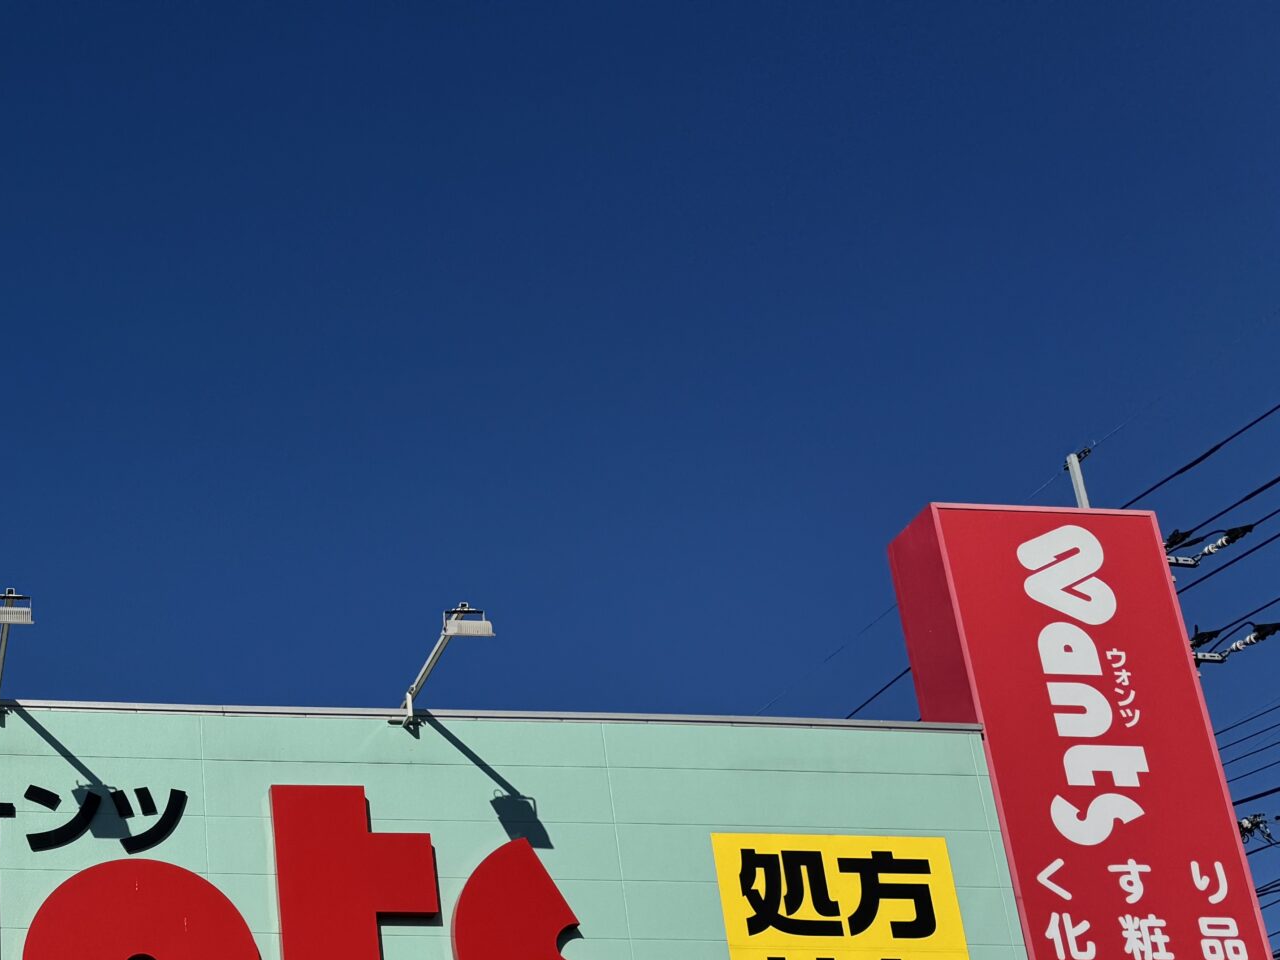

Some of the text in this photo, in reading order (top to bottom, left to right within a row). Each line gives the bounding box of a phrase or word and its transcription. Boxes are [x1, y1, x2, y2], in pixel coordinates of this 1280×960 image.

[1017, 525, 1149, 846] Wants
[1106, 647, 1140, 728] ウォンツ
[739, 848, 937, 939] 処方
